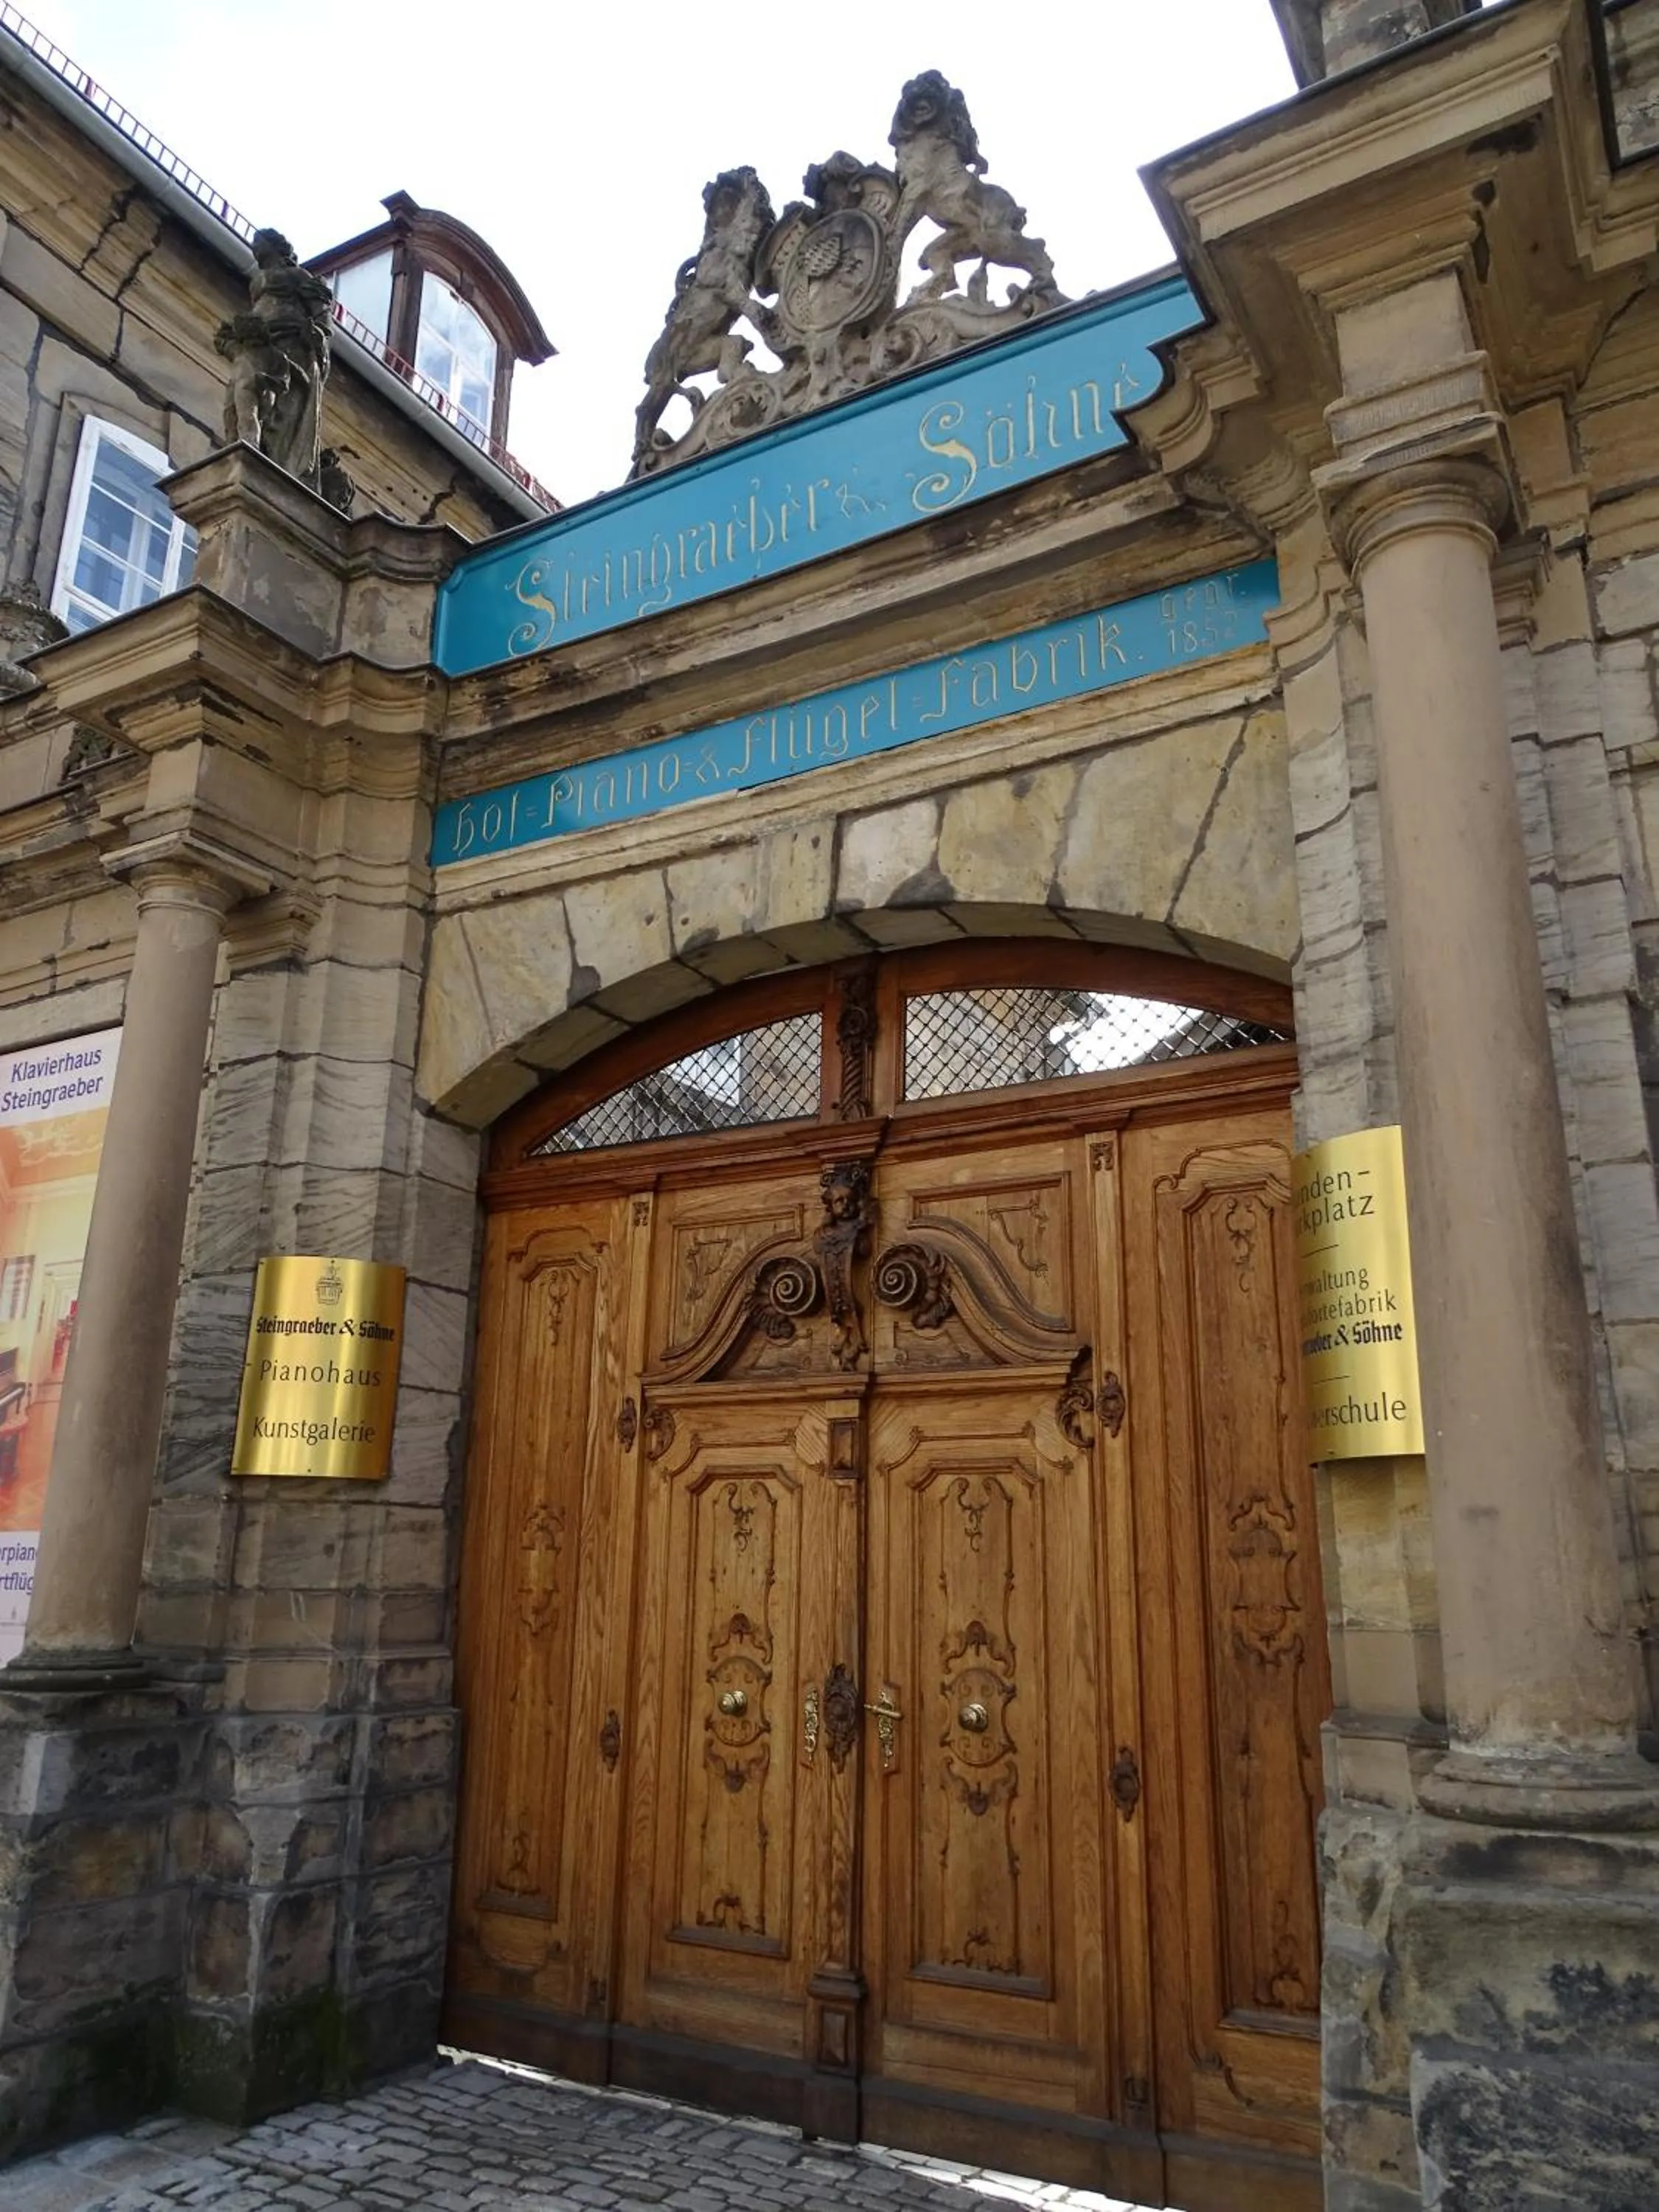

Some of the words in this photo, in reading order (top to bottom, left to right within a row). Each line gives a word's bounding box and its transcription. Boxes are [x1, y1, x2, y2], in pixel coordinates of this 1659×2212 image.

[10, 1048, 102, 1083] Klavierhaus
[0, 1075, 103, 1112] Steingraeber
[256, 1315, 337, 1337] Steingraeber
[338, 1318, 355, 1337] &
[358, 1318, 396, 1342] Söhne
[1334, 1324, 1349, 1346] &
[1352, 1319, 1403, 1345] Söhne
[259, 1358, 382, 1387] Pianohaus
[253, 1416, 377, 1446] Kunstgalerie
